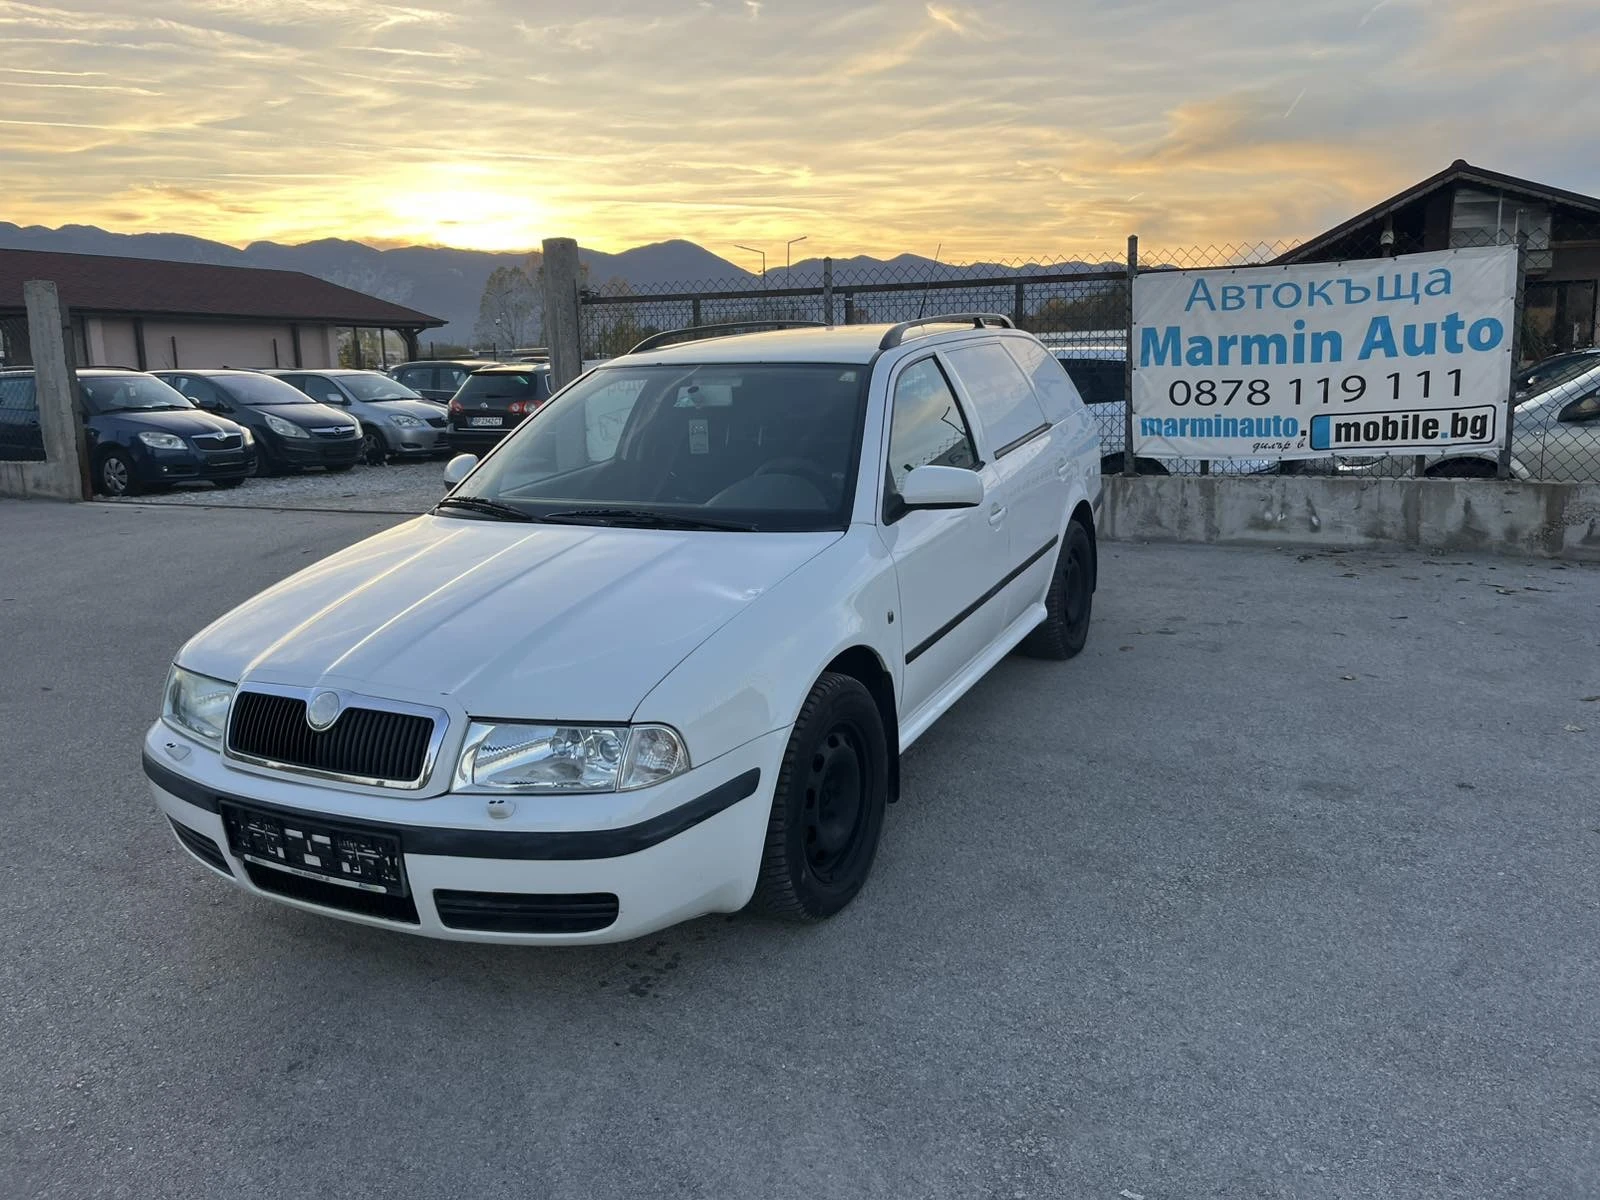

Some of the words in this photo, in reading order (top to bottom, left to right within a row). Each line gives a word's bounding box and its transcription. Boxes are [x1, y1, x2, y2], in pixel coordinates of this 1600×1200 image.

[1185, 267, 1452, 312] Автокъща
[1140, 319, 1342, 367] Marmin
[1358, 312, 1504, 360] Auto
[1169, 379, 1270, 406] 0878
[1289, 375, 1367, 405] 119
[1386, 368, 1462, 399] 111
[1334, 411, 1488, 443] mobile.bg
